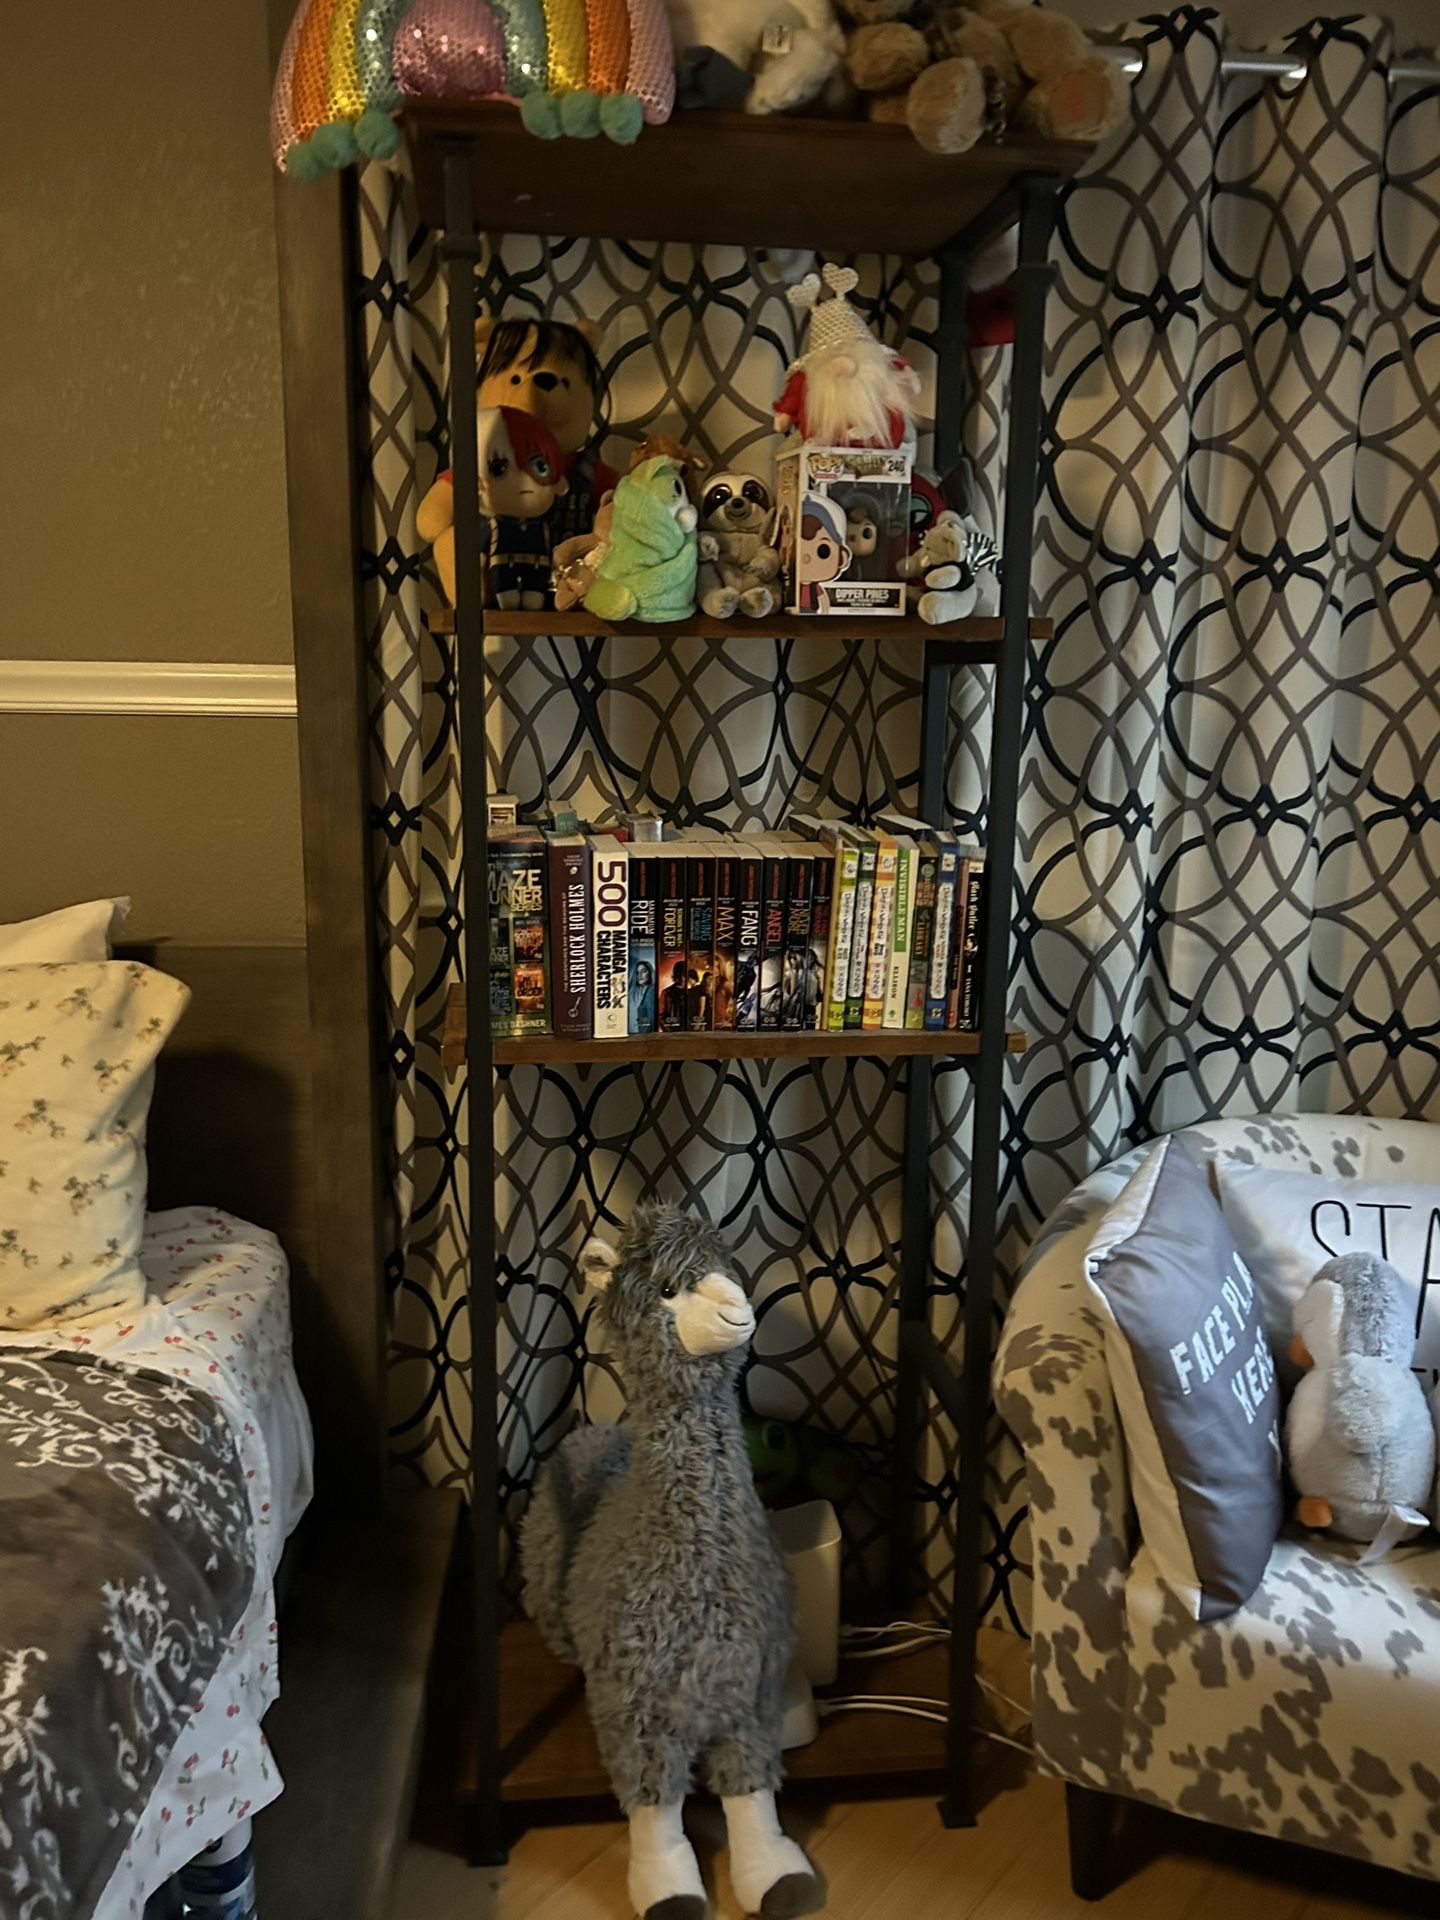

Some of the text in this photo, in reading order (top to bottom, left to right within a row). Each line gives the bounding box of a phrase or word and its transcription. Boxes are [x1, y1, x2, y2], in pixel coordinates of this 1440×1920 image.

[835, 589, 889, 600] DIPPER PINES
[568, 883, 585, 931] HOLMES
[598, 860, 627, 927] 500
[896, 859, 908, 942] INVISIBLE MAN
[967, 880, 981, 929] Black Butler
[631, 900, 649, 935] RIDE
[663, 907, 676, 947] FOREVER
[700, 907, 712, 941] SAVING
[717, 906, 735, 941] MAX
[741, 910, 759, 946] FANG
[766, 908, 783, 945] ANGEL
[570, 932, 587, 993] SHERLOCK
[597, 930, 611, 1009] CHARACTERS
[612, 930, 627, 974] MANGA
[891, 966, 899, 999] ELLISON
[1169, 1304, 1236, 1395] FACE
